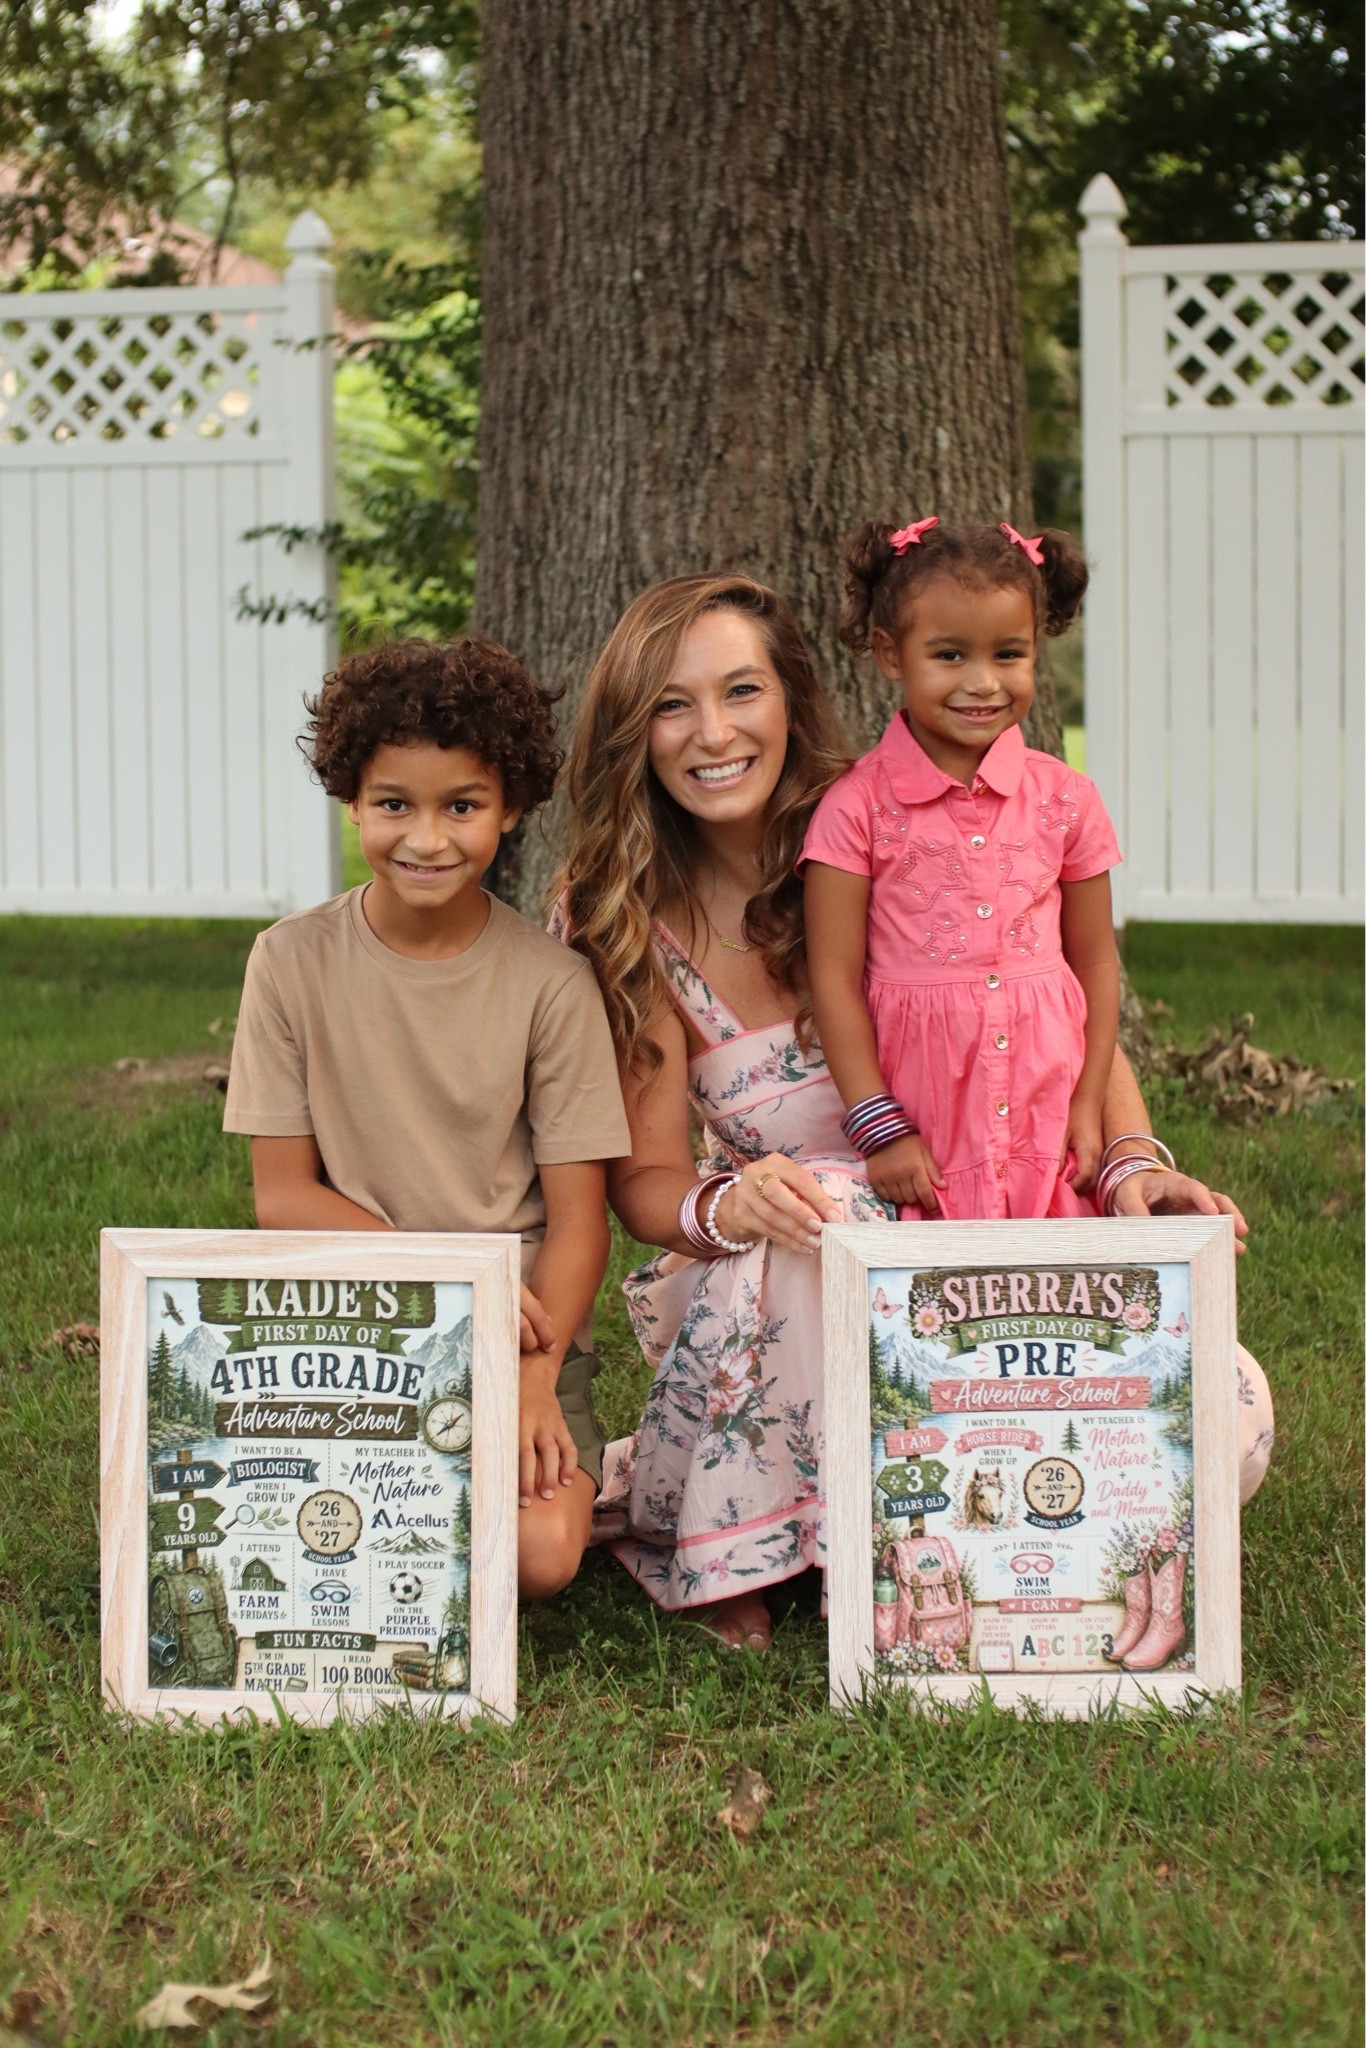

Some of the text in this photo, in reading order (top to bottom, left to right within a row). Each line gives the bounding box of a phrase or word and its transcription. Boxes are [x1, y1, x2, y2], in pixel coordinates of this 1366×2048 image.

[244, 1279, 399, 1320] KADE'S
[943, 1272, 1124, 1323] SIERRA'S
[253, 1324, 382, 1344] FIRST DAY OF
[981, 1320, 1094, 1339] FIRST DAY OF
[995, 1342, 1077, 1378] PRE
[210, 1352, 426, 1400] 4TH GRADE
[953, 1379, 1122, 1410] Adventure School
[224, 1400, 406, 1436] Adventure School
[966, 1418, 1026, 1427] I WANT TO BE A
[1082, 1416, 1146, 1425] MY TEACHER IS
[899, 1435, 932, 1450] I AM
[965, 1431, 1031, 1446] HORSE RIDER
[1088, 1428, 1148, 1450] Mother
[235, 1446, 303, 1456] I WANT TO BE A
[355, 1448, 427, 1457] MY TEACHER IS
[979, 1457, 1018, 1465] GROW UP
[1094, 1449, 1150, 1471] Nature
[172, 1469, 206, 1484] I AM
[236, 1461, 307, 1478] BIOLOGIST
[349, 1460, 416, 1485] Mother
[904, 1465, 924, 1493] 3
[254, 1482, 286, 1491] WHEN I
[373, 1478, 443, 1504] Nature
[1096, 1480, 1148, 1503] Daddy
[246, 1492, 296, 1503] GROW UP
[891, 1497, 945, 1513] YEARS OLD
[1090, 1501, 1168, 1521] and Mommy
[177, 1502, 196, 1532] 9
[320, 1519, 338, 1528] AND
[395, 1513, 449, 1528] Acellus
[1030, 1515, 1079, 1528] SCHOOL YEAR
[163, 1532, 218, 1546] YEARS OLD
[1013, 1541, 1053, 1550] I ATTEND
[240, 1543, 281, 1553] I ATTEND
[308, 1552, 351, 1564] SCHOOL YEAR
[378, 1560, 445, 1570] I PLAY SOCCER
[314, 1568, 348, 1577] I HAVE
[1016, 1577, 1050, 1587] SWIM
[1014, 1588, 1052, 1596] LESSONS
[238, 1595, 280, 1608] FARM
[1021, 1600, 1060, 1611] I CAN
[240, 1610, 279, 1620] FRIDAYS
[311, 1605, 350, 1617] SWIM
[393, 1606, 424, 1614] ON THE
[311, 1618, 350, 1627] LESSONS
[386, 1615, 431, 1625] PURPLE
[379, 1625, 438, 1636] PREDATORS
[273, 1633, 362, 1649] FUN FACTS
[258, 1653, 284, 1661] I'M IN
[342, 1655, 372, 1663] I READ
[244, 1662, 307, 1676] 5TH GRADE
[322, 1666, 402, 1685] 100 BOOKS
[245, 1678, 283, 1692] MATH
